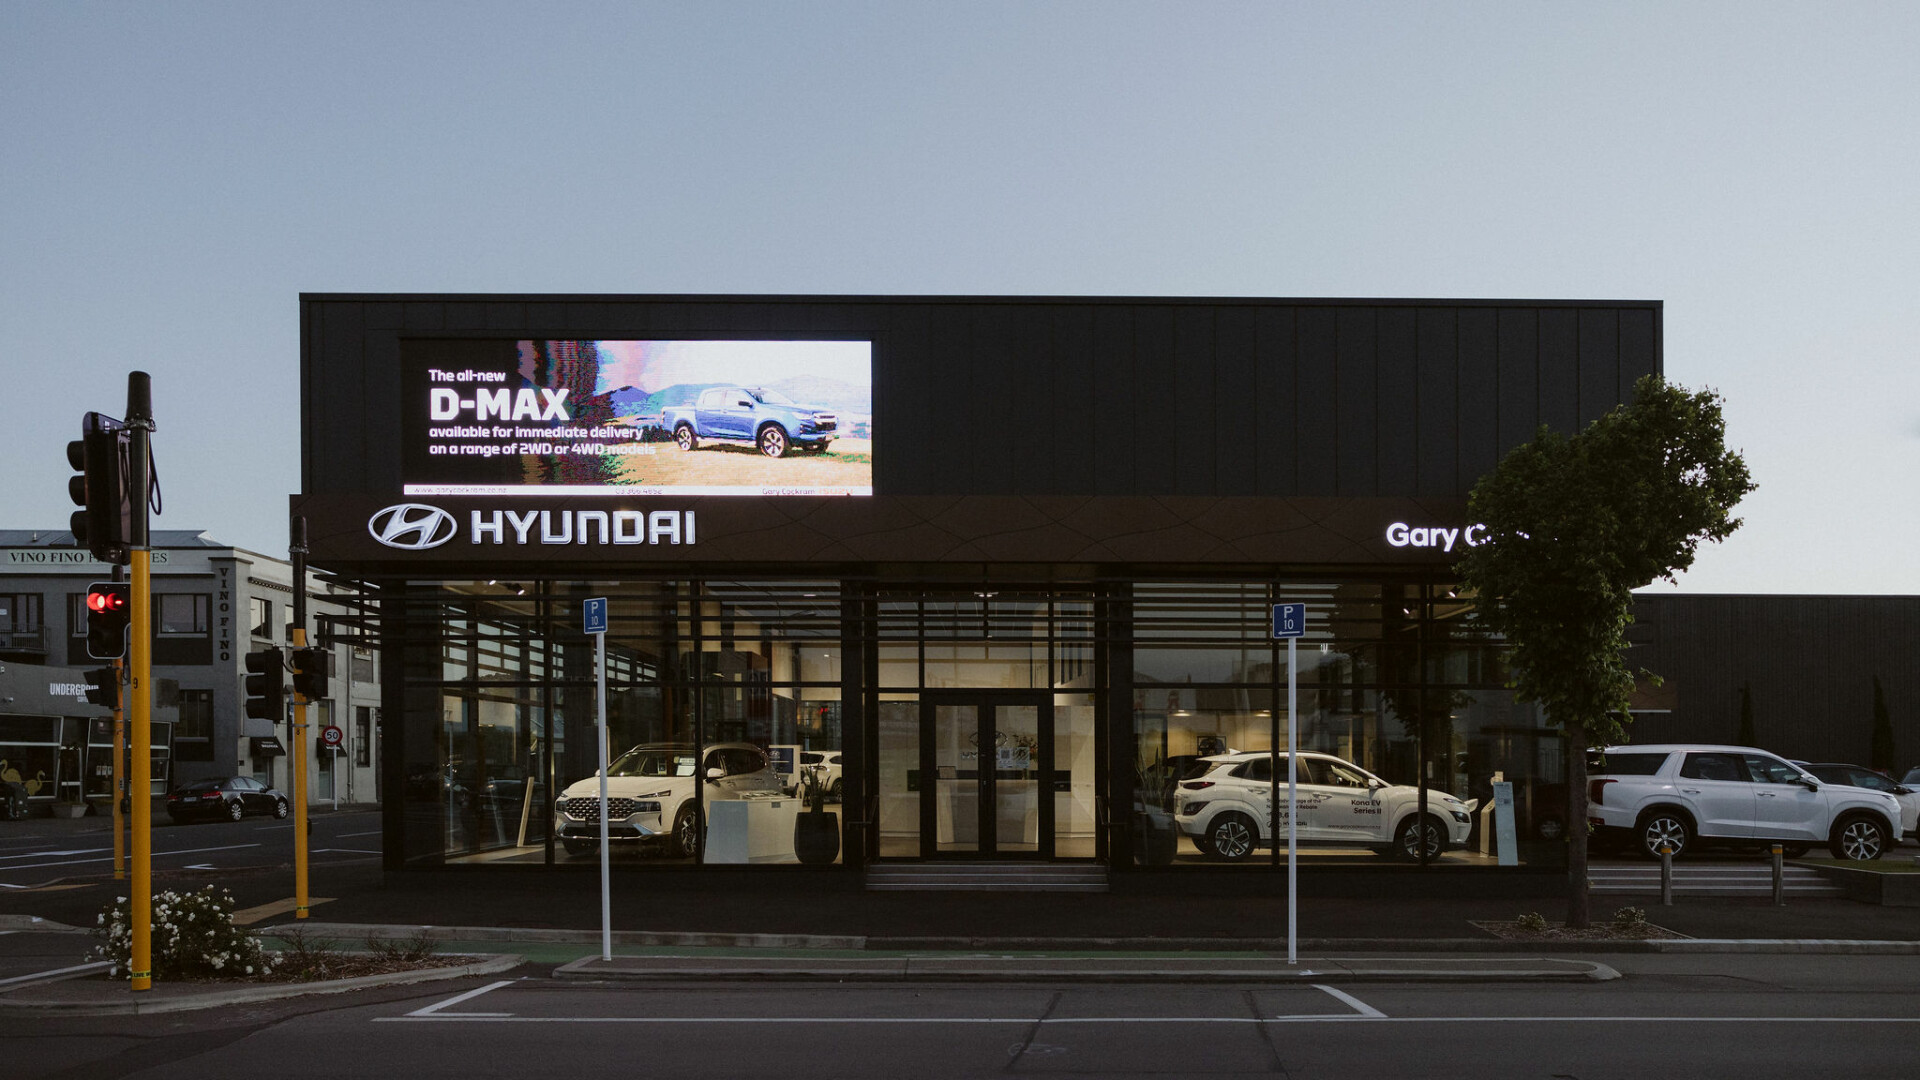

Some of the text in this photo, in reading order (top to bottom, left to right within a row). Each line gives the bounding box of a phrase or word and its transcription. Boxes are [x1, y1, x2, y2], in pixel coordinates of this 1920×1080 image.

[427, 369, 506, 382] The all-new
[430, 387, 571, 421] D-MAX
[429, 426, 643, 440] available for immediate delivery
[429, 443, 656, 457] on a range of 2WD or 4WD models
[471, 510, 697, 545] HYUNDAI
[1386, 522, 1459, 552] Gary
[10, 552, 46, 563] VINO
[50, 552, 84, 563] FINO
[219, 567, 230, 661] VINO FINO
[591, 601, 599, 614] P
[1283, 606, 1294, 619] P
[591, 615, 599, 626] 10
[1283, 619, 1294, 630] 10
[49, 682, 100, 696] UNDERGR
[326, 731, 339, 740] 50
[1371, 799, 1381, 807] EV
[1353, 807, 1375, 815] Series
